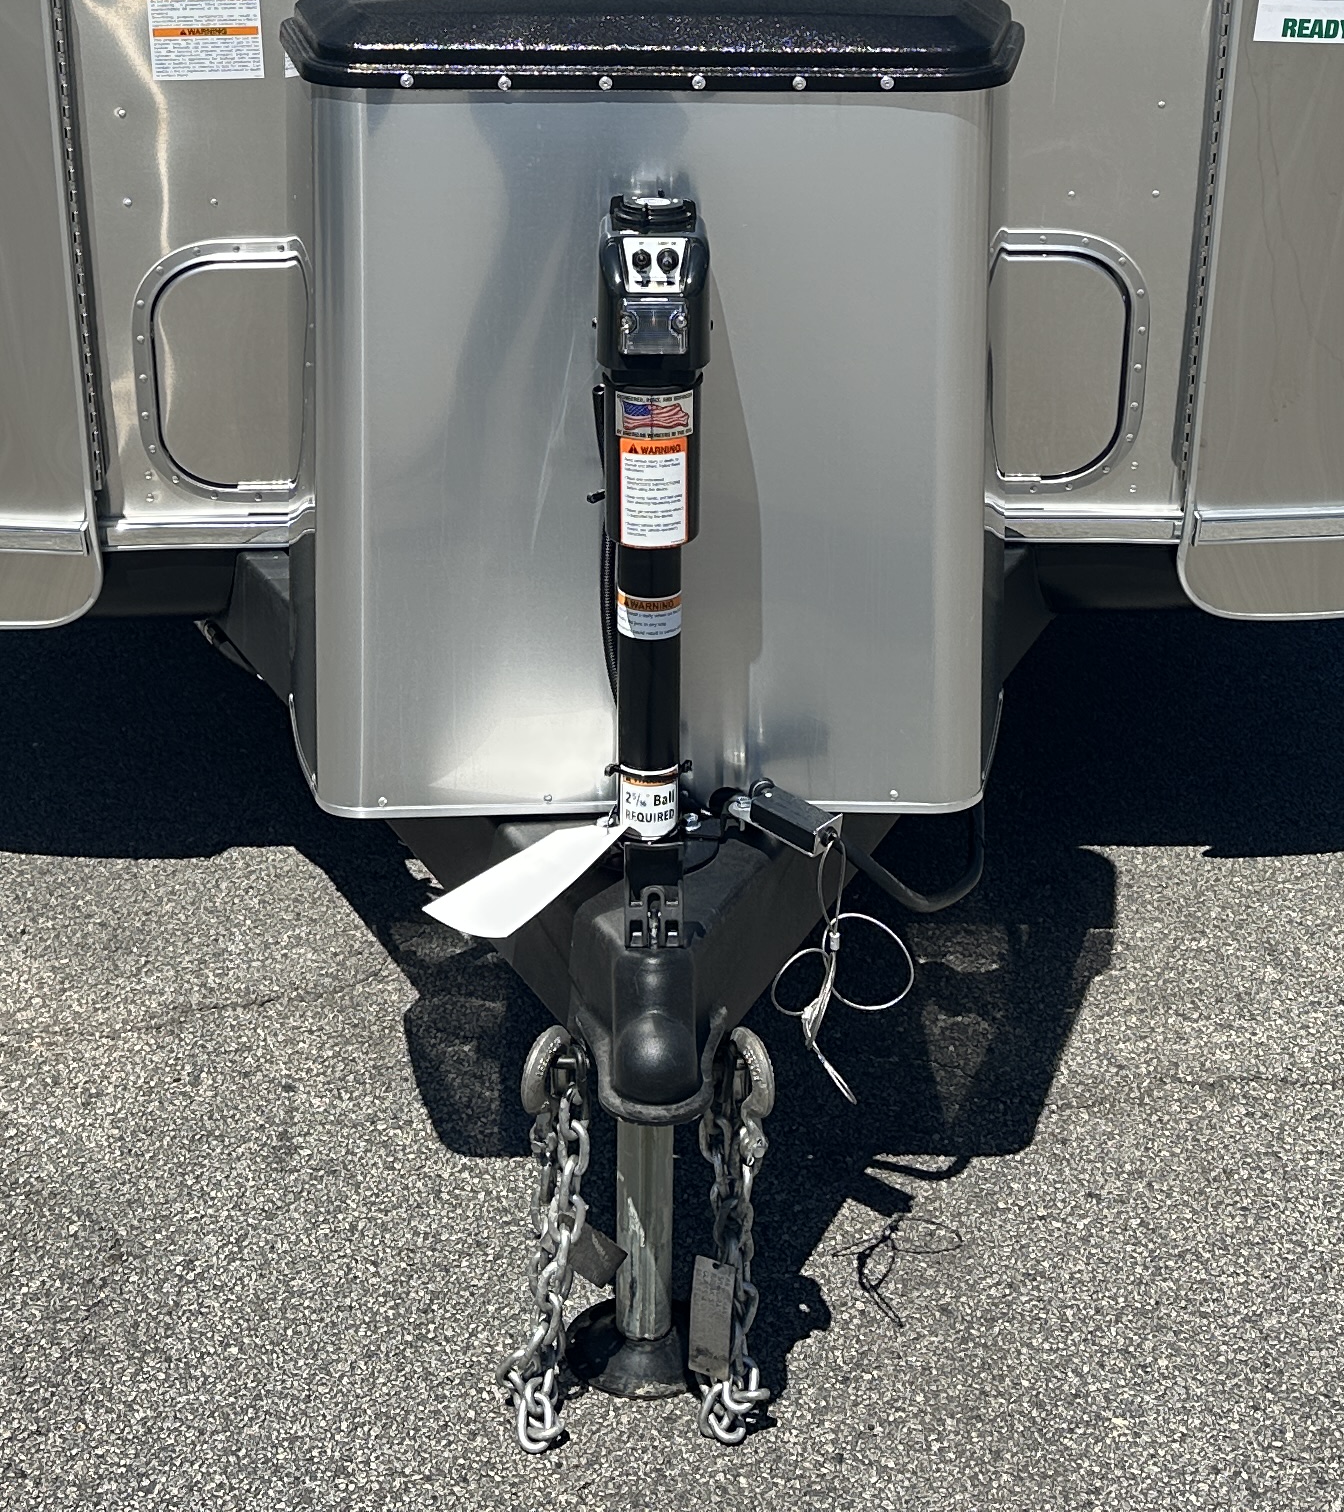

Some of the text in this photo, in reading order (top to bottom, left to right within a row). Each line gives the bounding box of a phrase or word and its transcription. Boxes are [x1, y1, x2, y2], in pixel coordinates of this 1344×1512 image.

[640, 444, 682, 455] WARNING
[630, 598, 674, 611] WARNING
[653, 789, 675, 807] Ball
[625, 808, 675, 824] REQUIRED
